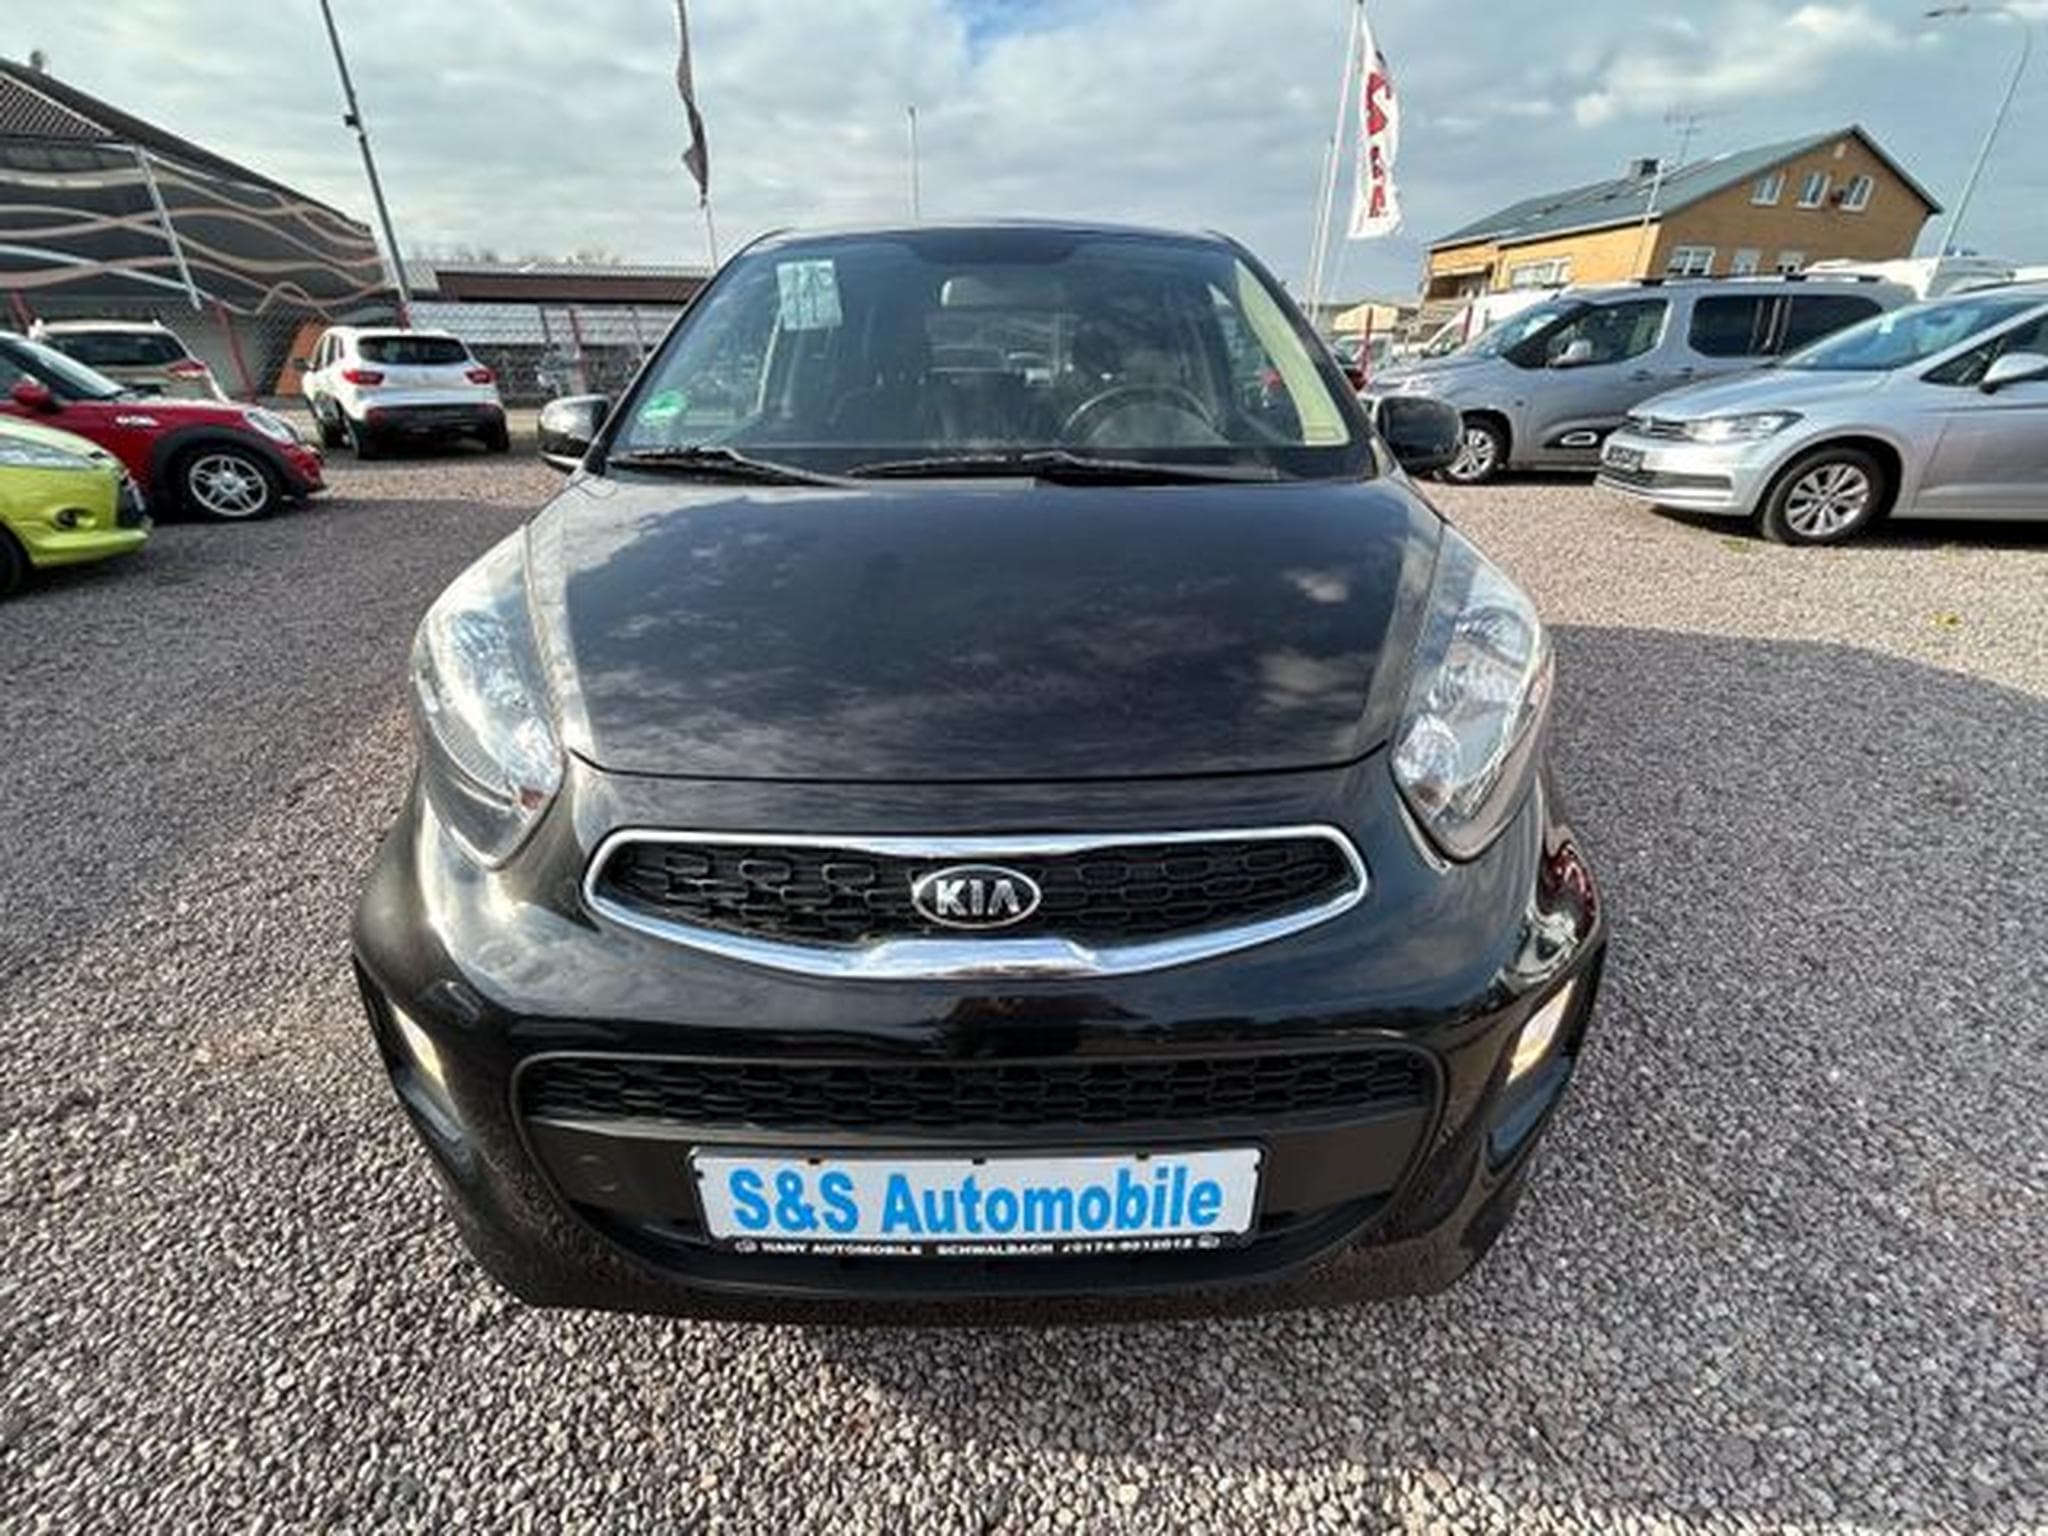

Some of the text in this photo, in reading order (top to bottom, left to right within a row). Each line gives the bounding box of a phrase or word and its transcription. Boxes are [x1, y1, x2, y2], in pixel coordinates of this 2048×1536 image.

[936, 879, 1020, 915] KIA
[729, 1166, 1223, 1235] S&S Automobile
